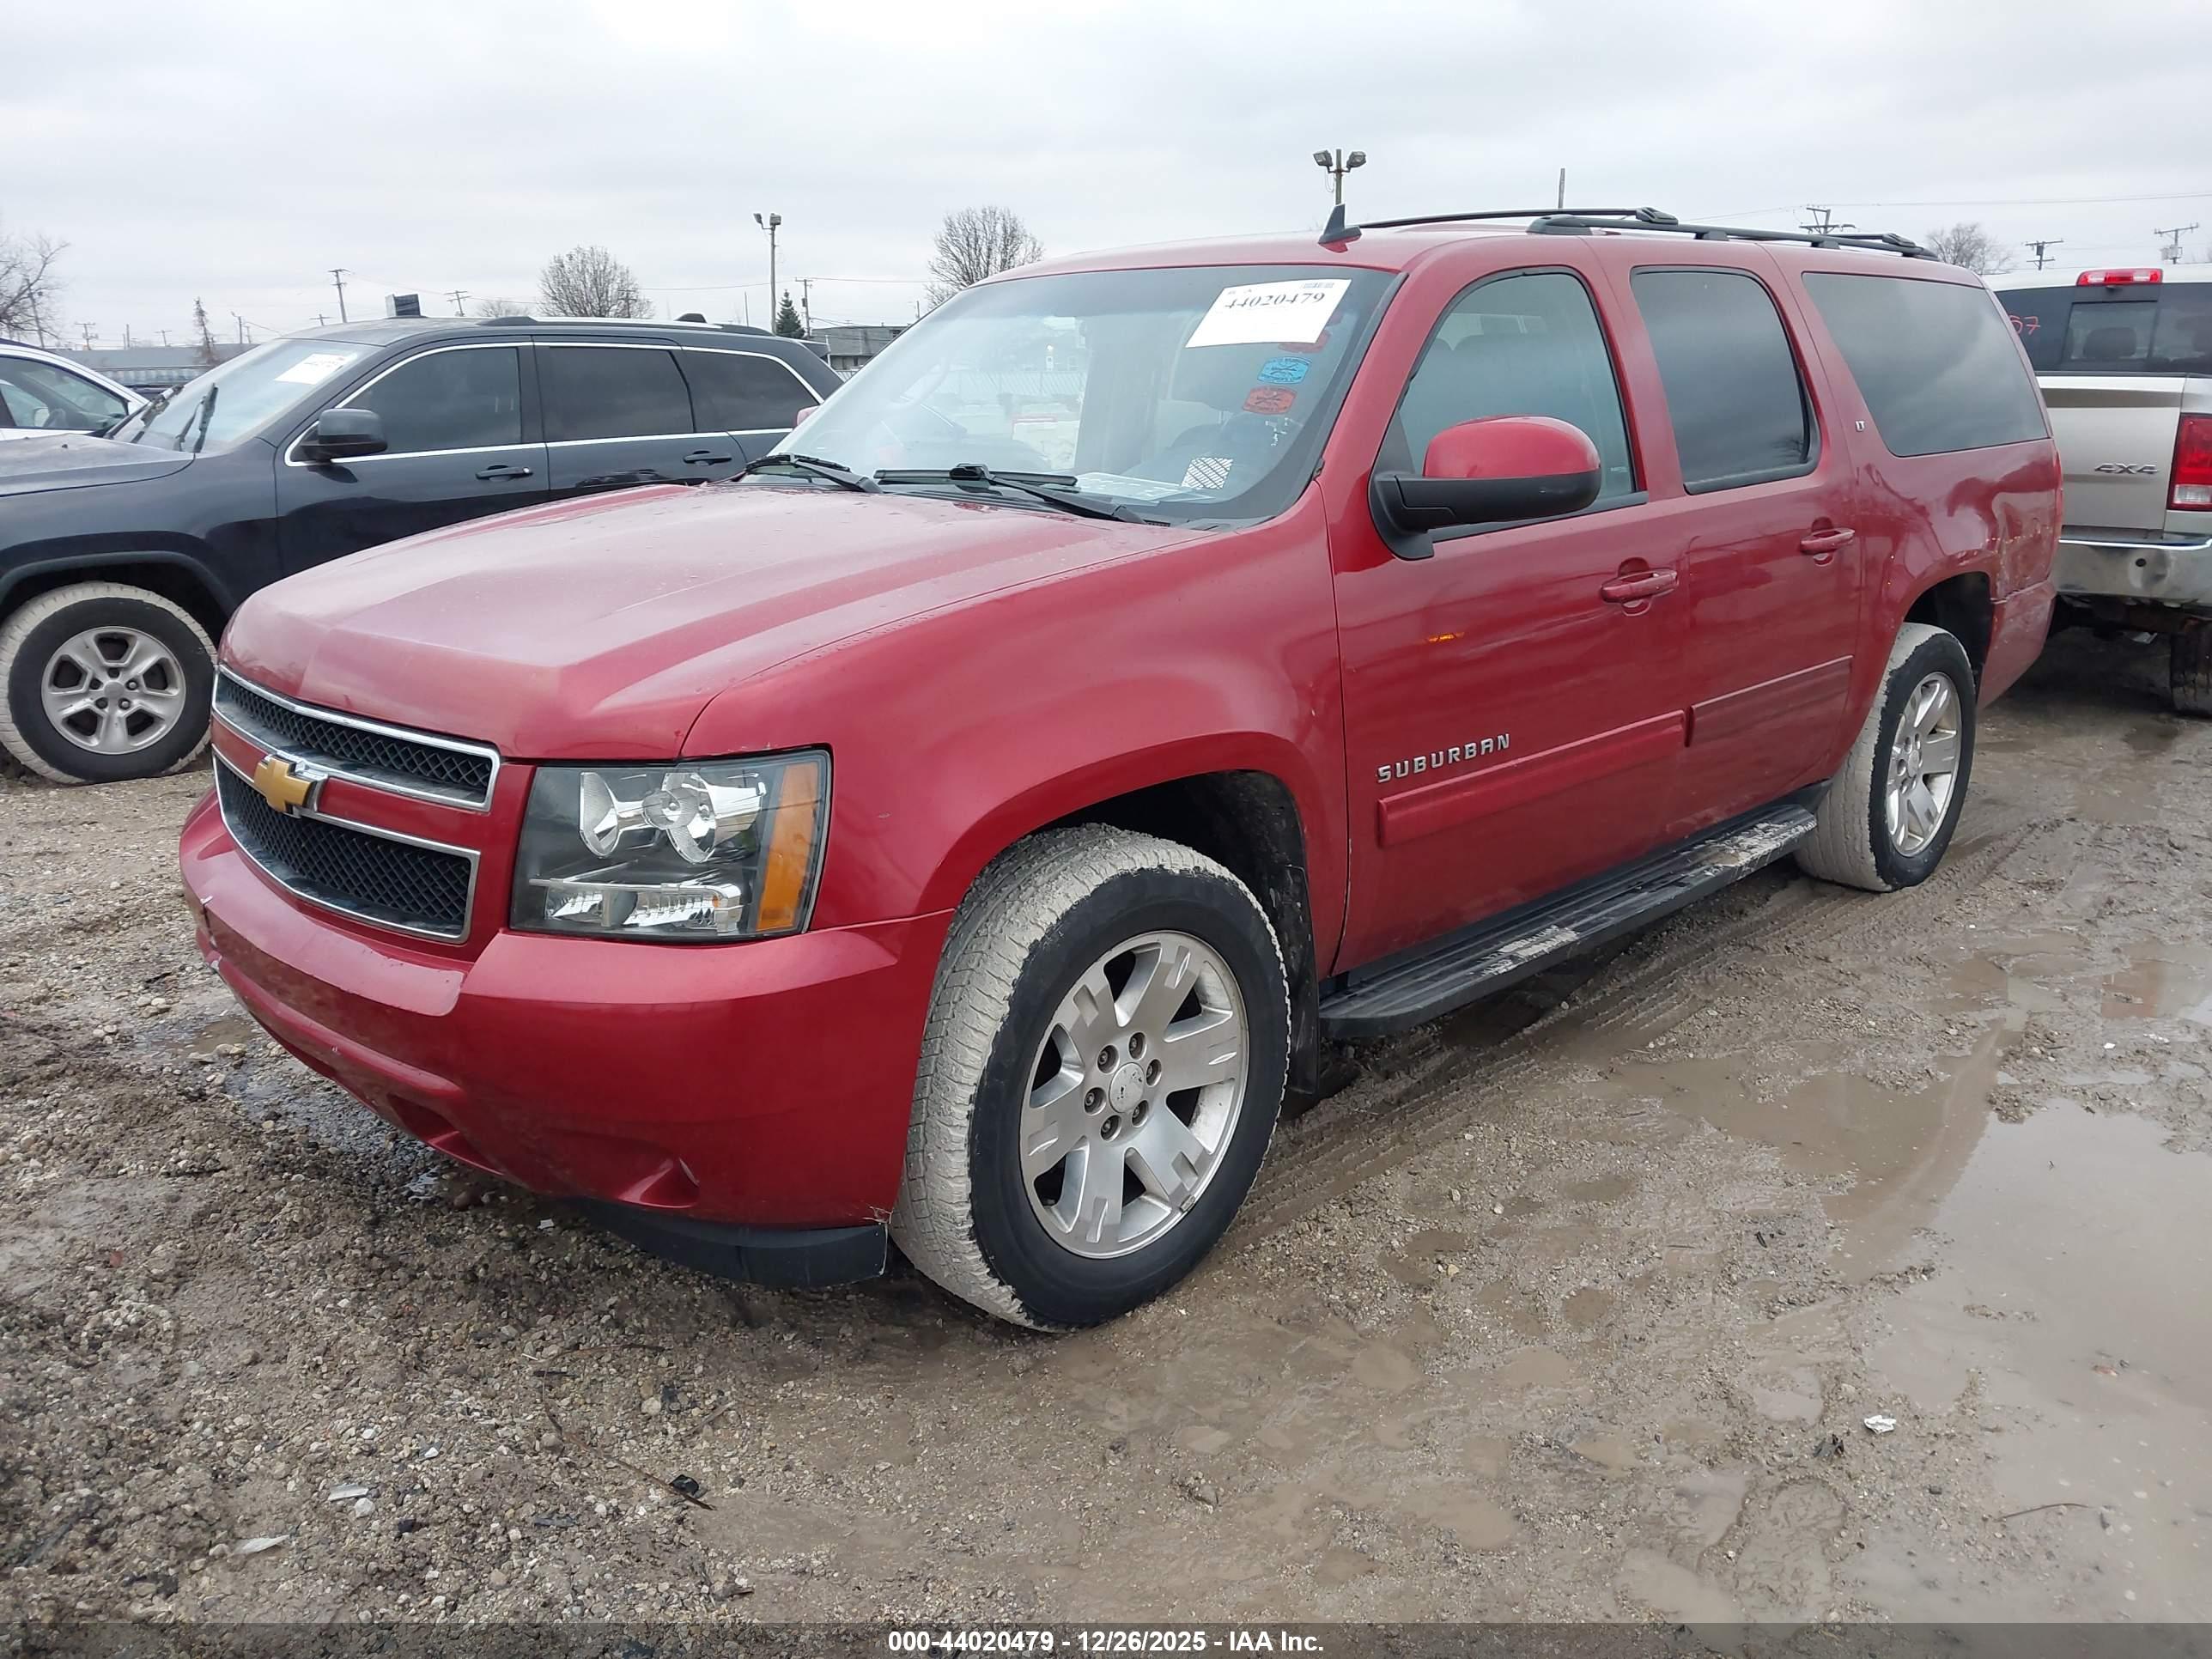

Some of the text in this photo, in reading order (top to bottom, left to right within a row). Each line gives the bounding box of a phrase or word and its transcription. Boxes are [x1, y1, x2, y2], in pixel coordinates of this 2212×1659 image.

[1224, 292, 1326, 309] 44020479
[1855, 420, 1866, 432] LT
[1376, 732, 1510, 783] SUBURBAN
